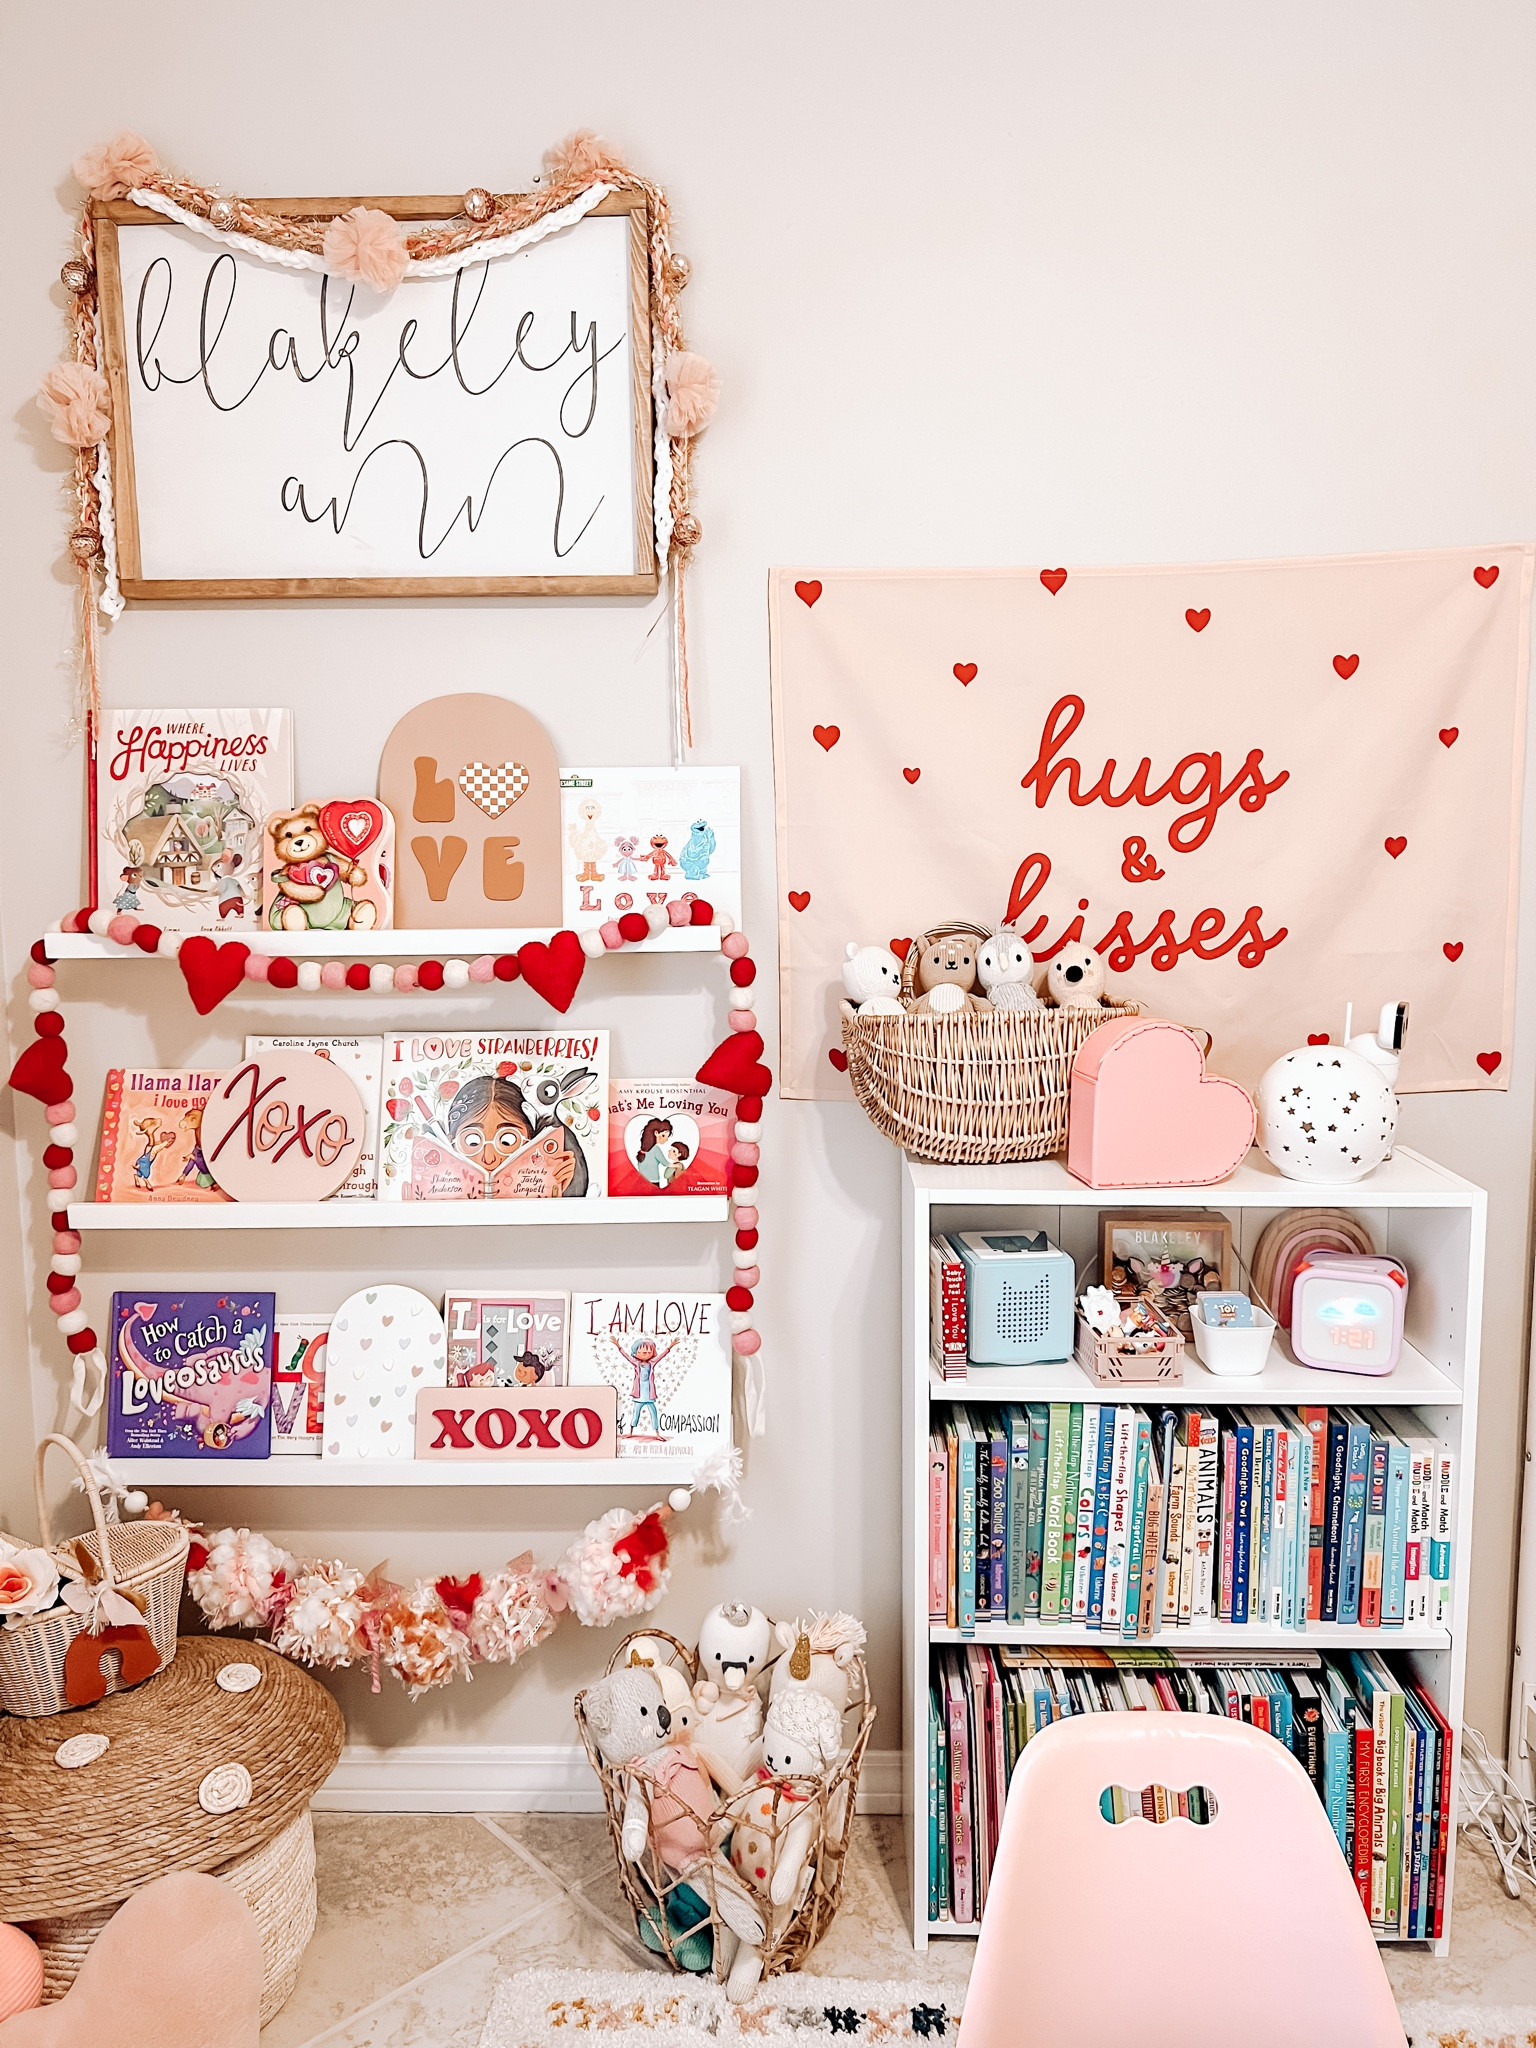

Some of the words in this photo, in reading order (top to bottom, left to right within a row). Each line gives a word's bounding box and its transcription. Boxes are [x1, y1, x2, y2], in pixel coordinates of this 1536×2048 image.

[137, 254, 626, 452] blakeley
[281, 438, 605, 558] ann
[166, 722, 206, 735] WHERE
[109, 725, 269, 781] Happiness
[219, 758, 258, 772] LIVES
[1020, 694, 1290, 853] hugs
[412, 756, 455, 823] L
[1121, 835, 1166, 883] &
[272, 1039, 305, 1047] Caroline
[307, 1039, 329, 1049] Jayne
[332, 1039, 359, 1047] Church
[392, 1040, 404, 1062] I
[411, 1037, 472, 1062] LOVE
[477, 1036, 599, 1062] STRAWBERRIES!
[130, 1073, 182, 1091] llama
[153, 1093, 159, 1107] i
[161, 1094, 188, 1108] love
[192, 1095, 209, 1110] yo
[636, 1098, 655, 1110] Me
[660, 1096, 703, 1115] Loving
[708, 1101, 729, 1117] You
[428, 1184, 463, 1194] Anderson
[432, 1174, 462, 1184] Shannon
[521, 1175, 543, 1187] Jaclyn
[1135, 1231, 1201, 1244] BLAKELEY
[946, 1270, 962, 1278] Baby
[452, 1301, 481, 1340] L
[482, 1314, 491, 1323] is
[493, 1314, 507, 1323] for
[507, 1308, 562, 1334] Love
[584, 1299, 603, 1335] I
[608, 1301, 645, 1333] AM
[654, 1302, 712, 1336] LOVE
[951, 1303, 959, 1322] Love
[1218, 1304, 1236, 1313] TOY
[139, 1317, 179, 1347] How
[153, 1346, 171, 1363] to
[174, 1315, 227, 1356] Catch
[232, 1318, 243, 1336] a
[951, 1323, 959, 1339] You
[1330, 1325, 1374, 1350] 1:21
[121, 1346, 265, 1416] Loveosaurus
[430, 1407, 603, 1449] XOXO
[660, 1413, 720, 1433] COMPASSION
[649, 1445, 663, 1454] PETER
[668, 1446, 694, 1456] REYNOLDS
[1051, 1429, 1065, 1489] Lift-the-flap
[1083, 1417, 1097, 1478] Lift-the-flap
[1102, 1422, 1114, 1473] Lift-the-flap
[1116, 1423, 1129, 1484] Lift-the-flap
[1253, 1440, 1262, 1457] All
[1278, 1438, 1288, 1459] Time
[1188, 1465, 1198, 1476] My
[1237, 1448, 1250, 1497] Goodnight,
[1304, 1466, 1310, 1475] as
[1331, 1445, 1345, 1494] Goodnight,
[1373, 1453, 1386, 1476] CAN
[1440, 1461, 1451, 1493] MUDDLE
[993, 1477, 1005, 1498] Zoo
[1064, 1471, 1081, 1506] Nature
[1169, 1485, 1183, 1511] Farm
[1187, 1477, 1197, 1494] First
[1196, 1449, 1216, 1523] ANIMALS
[963, 1487, 974, 1525] Under
[1048, 1494, 1064, 1527] Word
[1078, 1487, 1095, 1539] Colors
[1111, 1489, 1128, 1532] Shapes
[1186, 1494, 1196, 1513] Word
[1239, 1499, 1248, 1517] Owl
[1371, 1495, 1383, 1511] IT!
[993, 1501, 1005, 1534] Sounds
[1012, 1502, 1027, 1546] Bedtime
[1147, 1510, 1160, 1527] BUG
[1169, 1512, 1182, 1542] Sounds
[1185, 1514, 1195, 1531] Book
[1330, 1495, 1342, 1543] Chameleon!
[1411, 1509, 1420, 1534] Match
[1421, 1503, 1430, 1530] Match
[1439, 1508, 1449, 1534] Match
[963, 1526, 974, 1547] the
[1223, 1521, 1234, 1539] What
[1391, 1524, 1401, 1553] Animal
[1047, 1531, 1062, 1564] Book
[1144, 1531, 1157, 1559] HOTEL
[1223, 1544, 1233, 1556] are
[963, 1548, 974, 1573] Sea
[1012, 1549, 1026, 1598] Favorites
[1409, 1546, 1418, 1576] Imagine
[1438, 1543, 1447, 1578] Adventure
[1078, 1565, 1087, 1595] Usborne
[1111, 1572, 1119, 1602] Usborne
[1222, 1560, 1233, 1593] feelings?
[1347, 1583, 1355, 1602] Miller
[1378, 1712, 1386, 1737] Usborne
[1308, 1726, 1317, 1775] EVERYTHING
[1360, 1741, 1370, 1758] MY
[1375, 1739, 1387, 1755] Big
[952, 1741, 964, 1780] 5-Minute
[1376, 1756, 1387, 1777] book
[1360, 1761, 1370, 1787] FIRST
[1376, 1777, 1385, 1786] of
[1346, 1783, 1355, 1809] PLANET
[1374, 1787, 1387, 1804] Big
[954, 1815, 965, 1845] Stories
[1332, 1796, 1344, 1838] Numbers
[1346, 1812, 1355, 1833] EARTH
[1358, 1790, 1370, 1865] ENCYCLOPEDIA
[1373, 1805, 1387, 1849] Animals
[1412, 1850, 1421, 1874] Dragon
[1421, 1853, 1429, 1871] Alien
